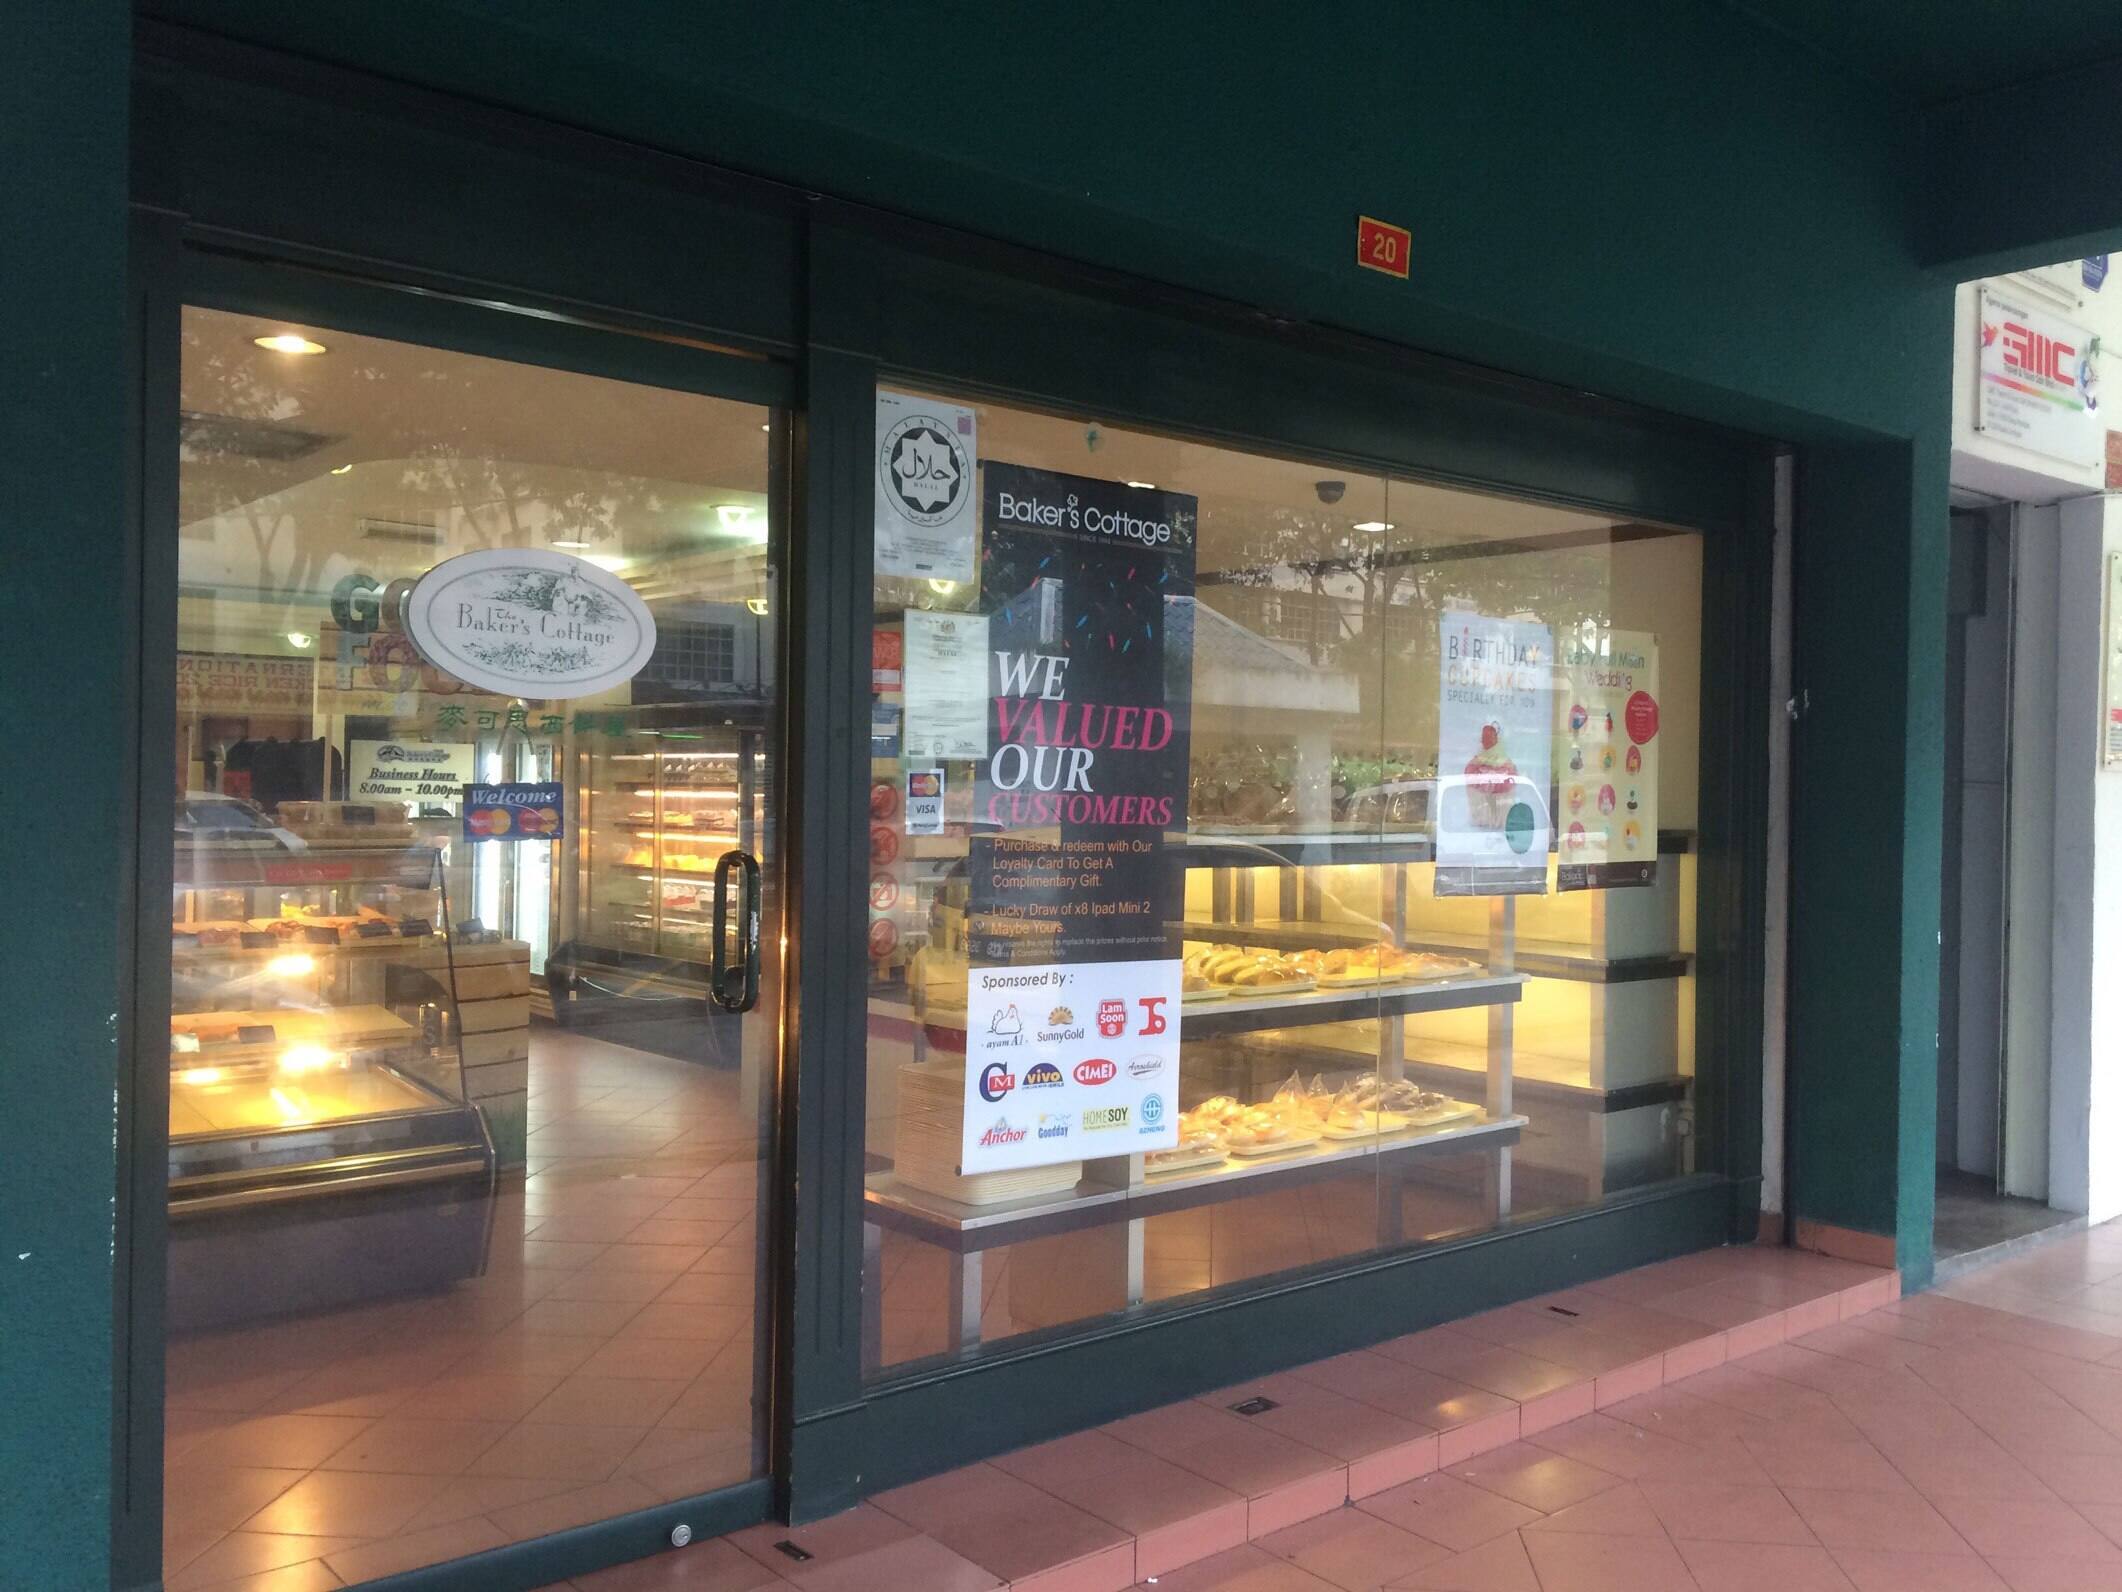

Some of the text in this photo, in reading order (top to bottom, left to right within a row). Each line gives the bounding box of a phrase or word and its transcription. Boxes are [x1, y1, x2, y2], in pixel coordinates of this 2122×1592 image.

[1373, 232, 1397, 263] 20
[999, 492, 1171, 546] Baker's Cottage
[496, 608, 516, 620] The
[457, 602, 614, 647] Baker's Cottage
[995, 651, 1069, 700] WE
[995, 696, 1173, 750] VALUED
[369, 767, 457, 780] Business Hours
[990, 743, 1094, 792] OUR
[359, 783, 402, 794] 8.00am
[416, 783, 463, 799] 10.00pm
[472, 788, 557, 804] Welcome
[916, 804, 936, 814] VISA
[987, 793, 1174, 825] CUSTOMERS
[994, 838, 1047, 852] Purchase
[1062, 839, 1106, 852] redeem
[1108, 839, 1129, 852] with
[1132, 839, 1152, 852] Our
[992, 856, 1114, 873] Loyalty Card To Get A
[992, 874, 1077, 890] Complimentary
[992, 901, 1151, 919] Lucky Draw of x8 Ipad Mini 2
[991, 922, 1030, 938] Maybe
[981, 973, 1048, 991] Sponsored
[1052, 971, 1067, 986] By
[1102, 1004, 1122, 1014] Lam
[1100, 1013, 1125, 1024] Soon
[1037, 1028, 1085, 1043] SunnyGold
[986, 1039, 1009, 1049] ayam
[1027, 1068, 1061, 1084] vivo
[979, 1127, 1027, 1146] Anchor
[1038, 1125, 1069, 1139] Goodday
